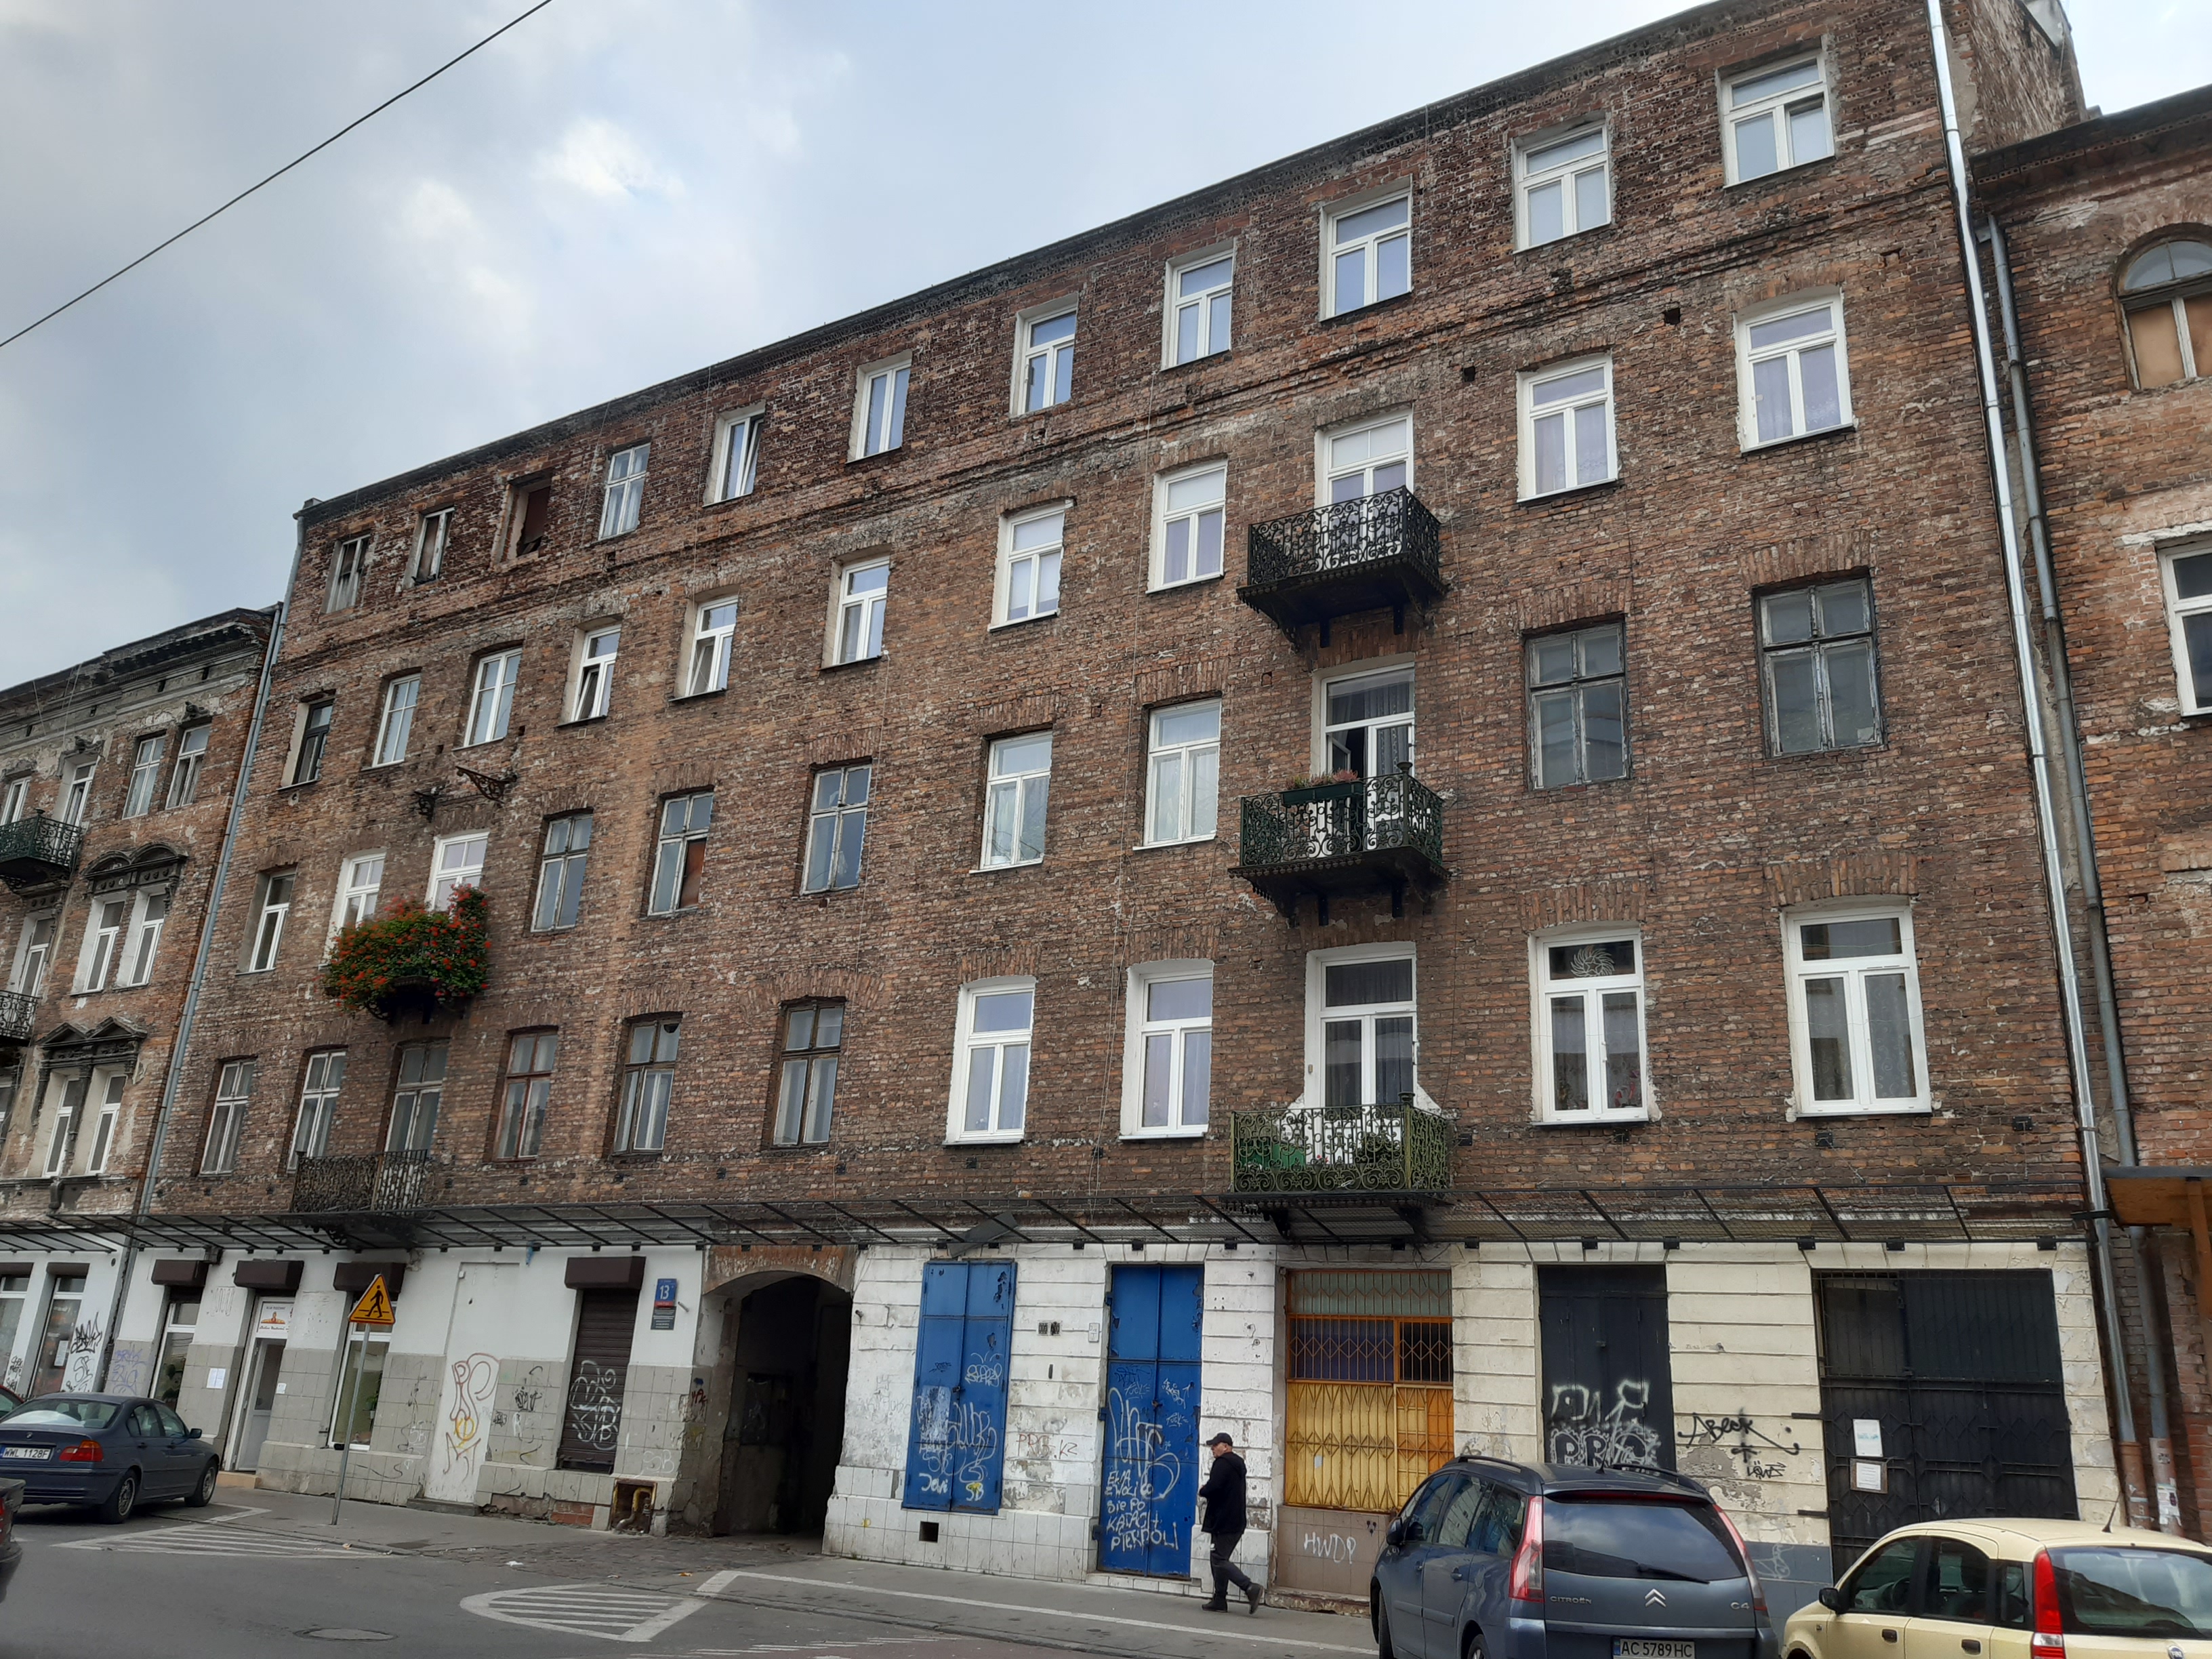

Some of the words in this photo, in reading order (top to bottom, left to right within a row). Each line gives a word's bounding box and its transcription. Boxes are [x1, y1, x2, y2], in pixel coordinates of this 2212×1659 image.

[660, 1285, 670, 1300] 13
[4, 1448, 19, 1458] WWL
[24, 1448, 49, 1459] 1128F
[1304, 1532, 1356, 1564] HWDP
[1730, 1601, 1750, 1610] C4
[1621, 1641, 1639, 1656] AC
[1643, 1642, 1672, 1657] 5789
[1675, 1643, 1692, 1658] HC
